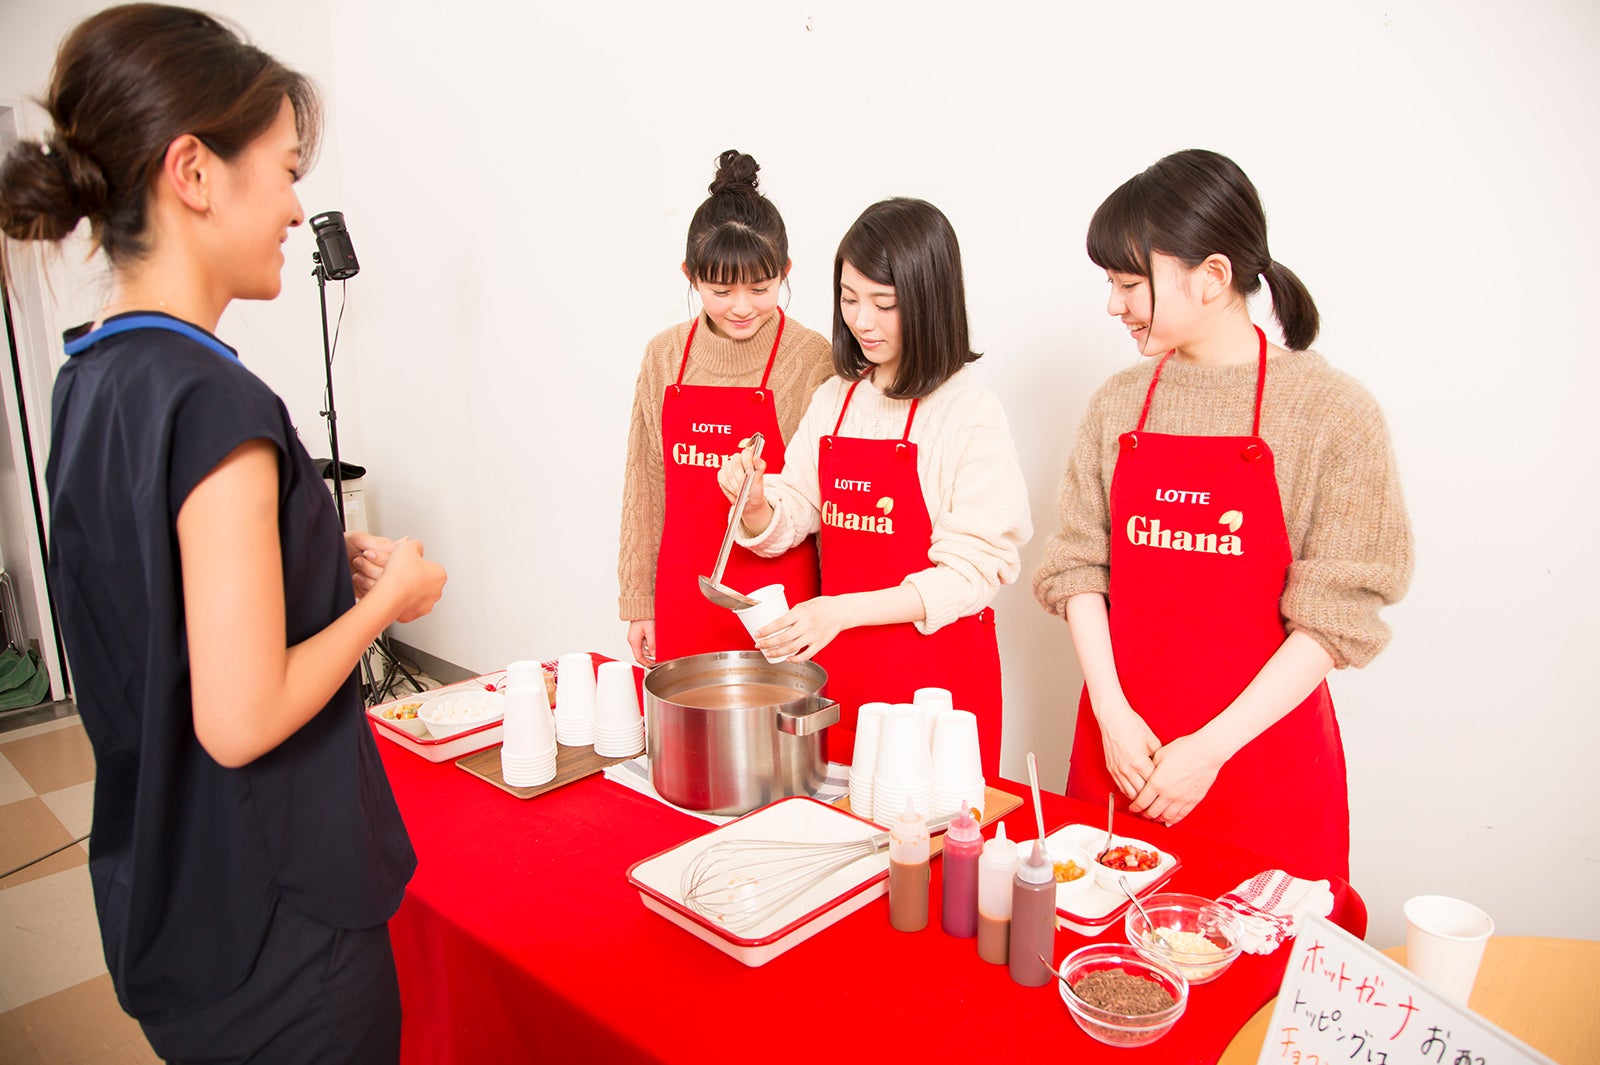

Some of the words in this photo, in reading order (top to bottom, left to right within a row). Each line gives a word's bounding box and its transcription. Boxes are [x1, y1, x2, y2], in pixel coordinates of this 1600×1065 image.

[692, 422, 732, 435] LOTTE
[672, 442, 735, 469] Ghan
[834, 478, 872, 493] LOTTE
[1155, 488, 1211, 505] LOTTE
[821, 500, 895, 535] Ghana
[1126, 515, 1244, 556] Ghana
